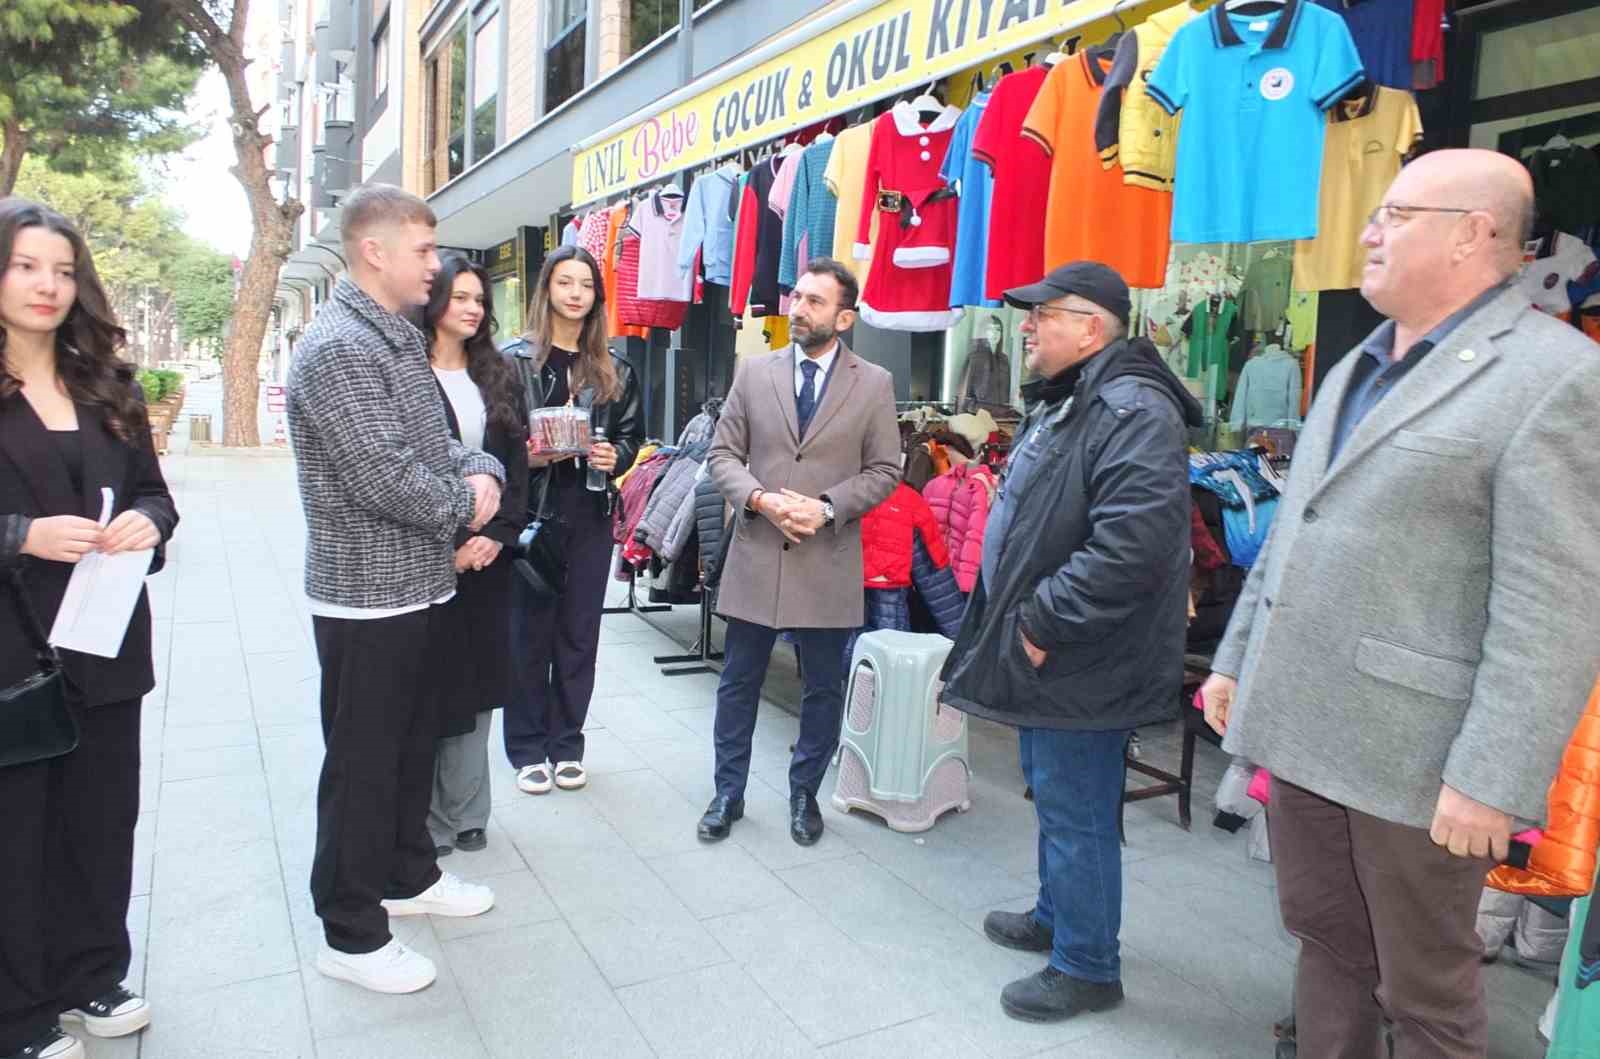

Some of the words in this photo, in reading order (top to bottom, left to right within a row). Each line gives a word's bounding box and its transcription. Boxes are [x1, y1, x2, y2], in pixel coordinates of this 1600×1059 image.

[633, 111, 697, 179] Bebe
[713, 67, 791, 153] ÇOCUK
[798, 69, 812, 110] &
[826, 10, 912, 98] OKUL
